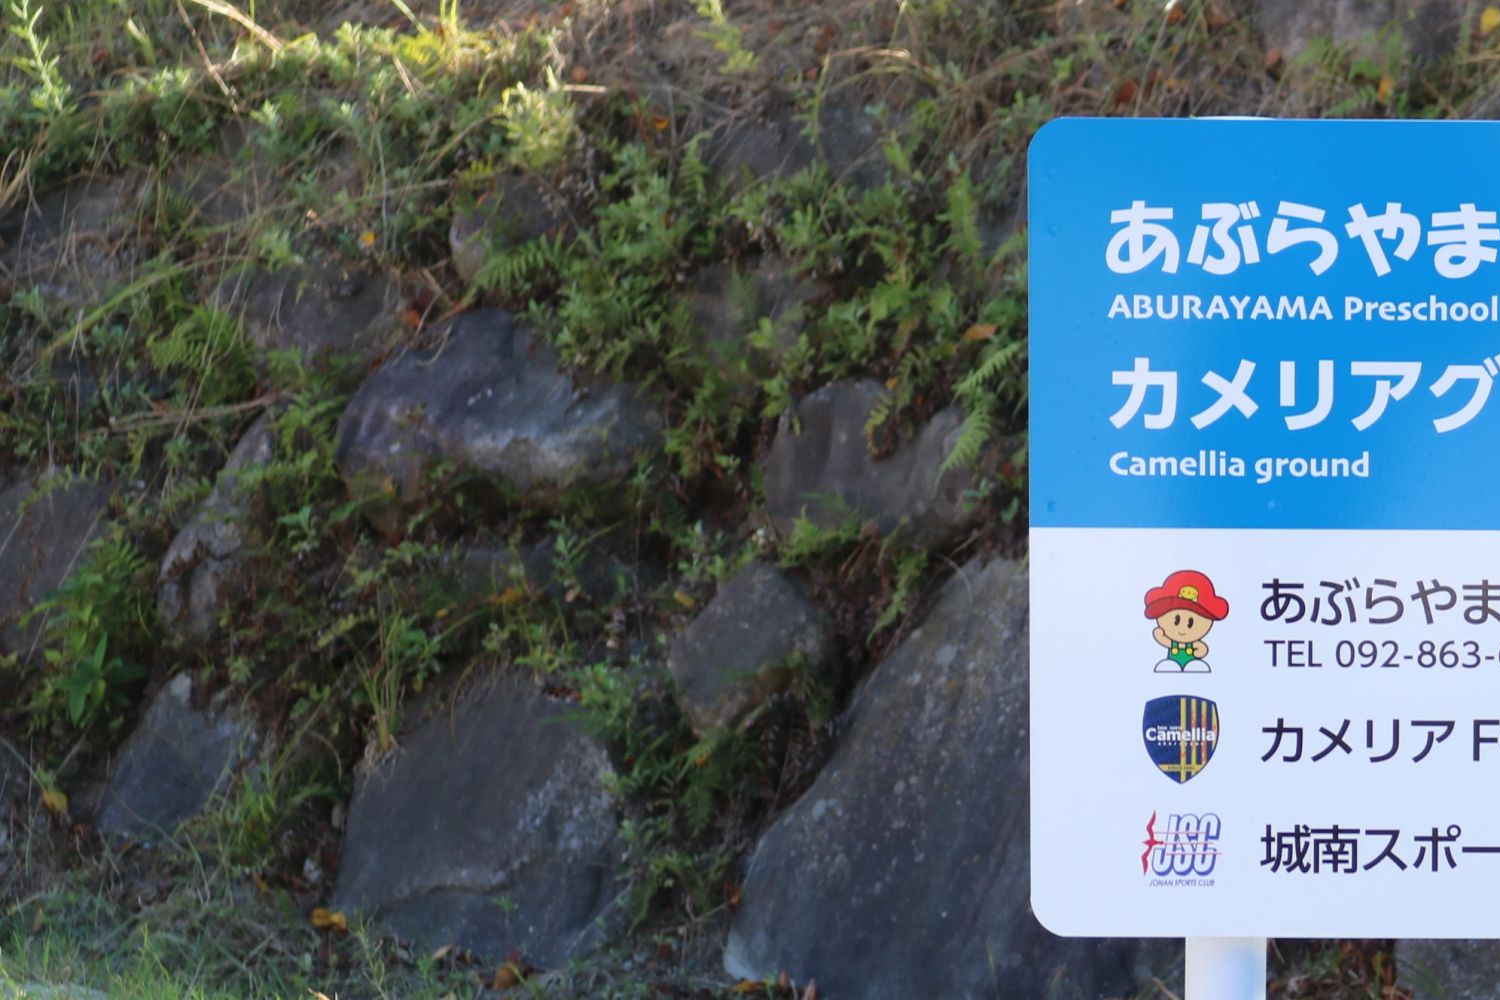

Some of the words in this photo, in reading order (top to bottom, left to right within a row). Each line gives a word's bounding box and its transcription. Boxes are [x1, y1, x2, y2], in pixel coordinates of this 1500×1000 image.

[1108, 295, 1333, 321] ABURAYAMA
[1345, 296, 1499, 322] Preschool
[1109, 451, 1246, 477] Camellia
[1254, 452, 1370, 484] ground
[1264, 640, 1322, 668] TEL
[1145, 726, 1216, 742] Camellia
[1260, 719, 1456, 763] カメリア
